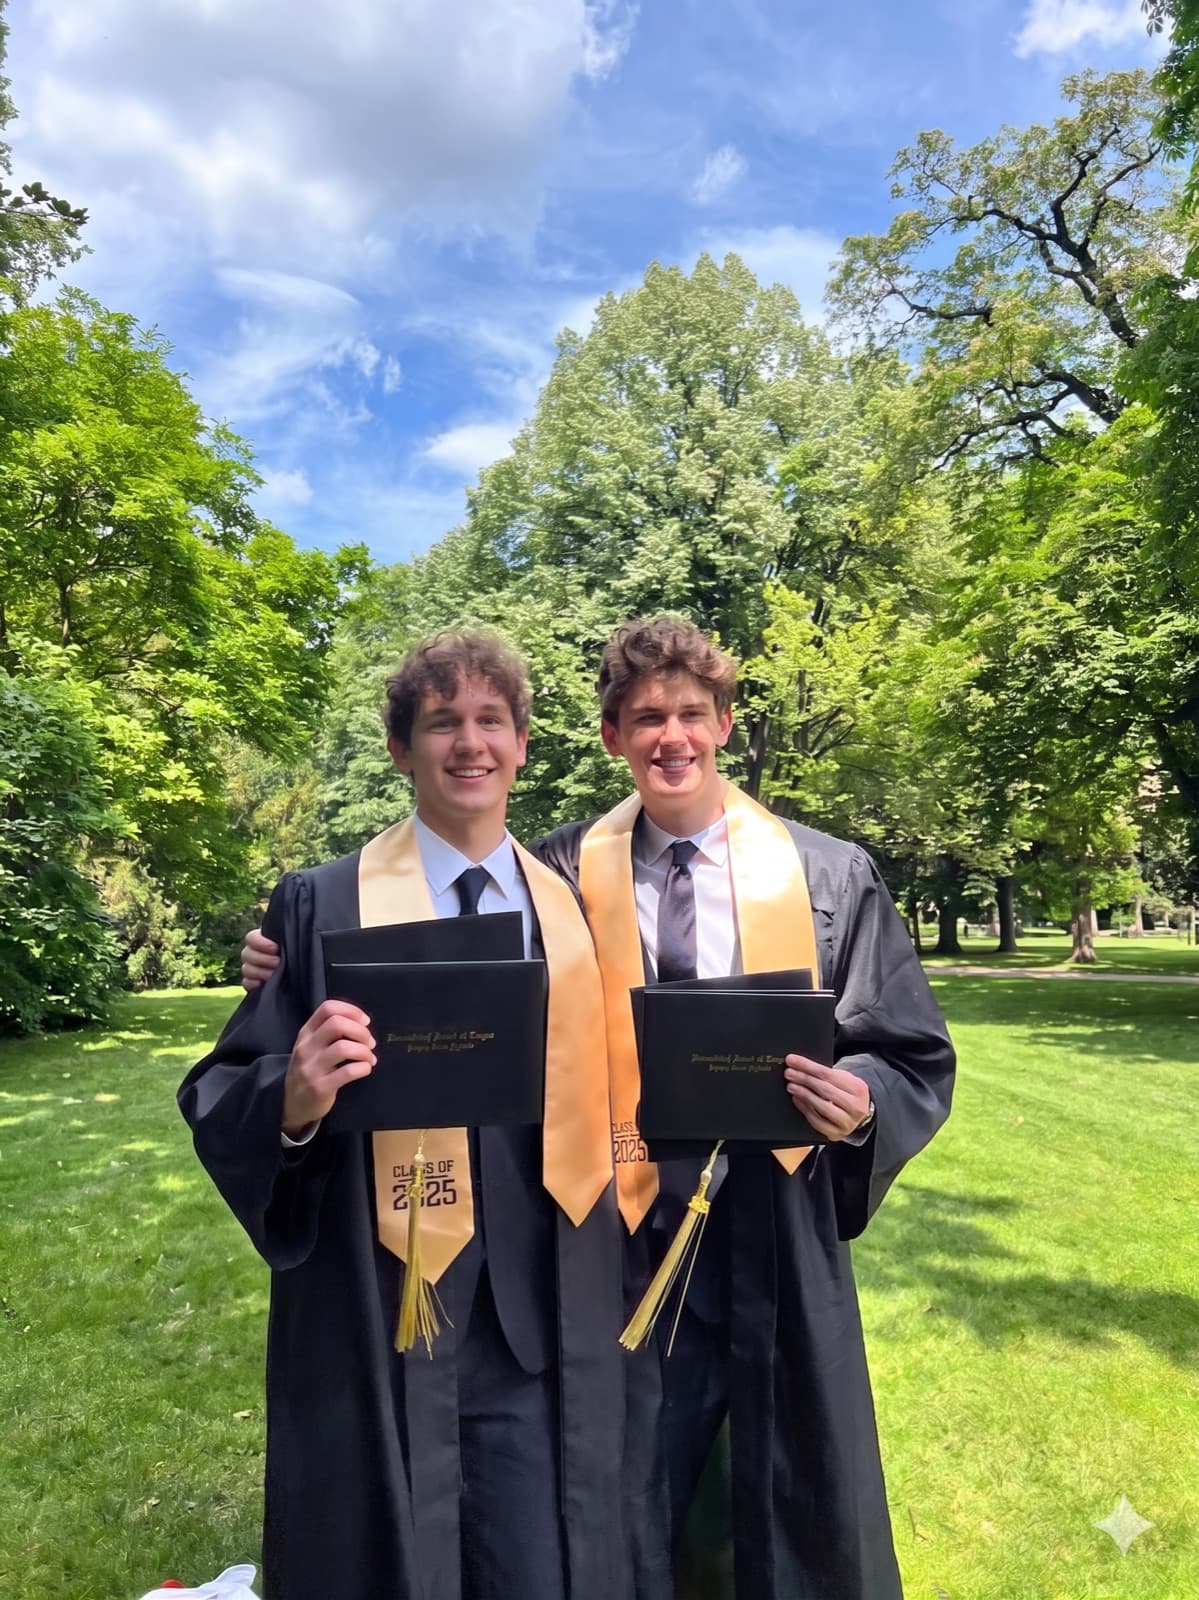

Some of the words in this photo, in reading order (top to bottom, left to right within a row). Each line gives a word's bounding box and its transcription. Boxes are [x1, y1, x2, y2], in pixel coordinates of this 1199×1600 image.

[613, 1138, 647, 1164] 2025
[438, 1159, 455, 1174] OF
[392, 1178, 457, 1211] 225
